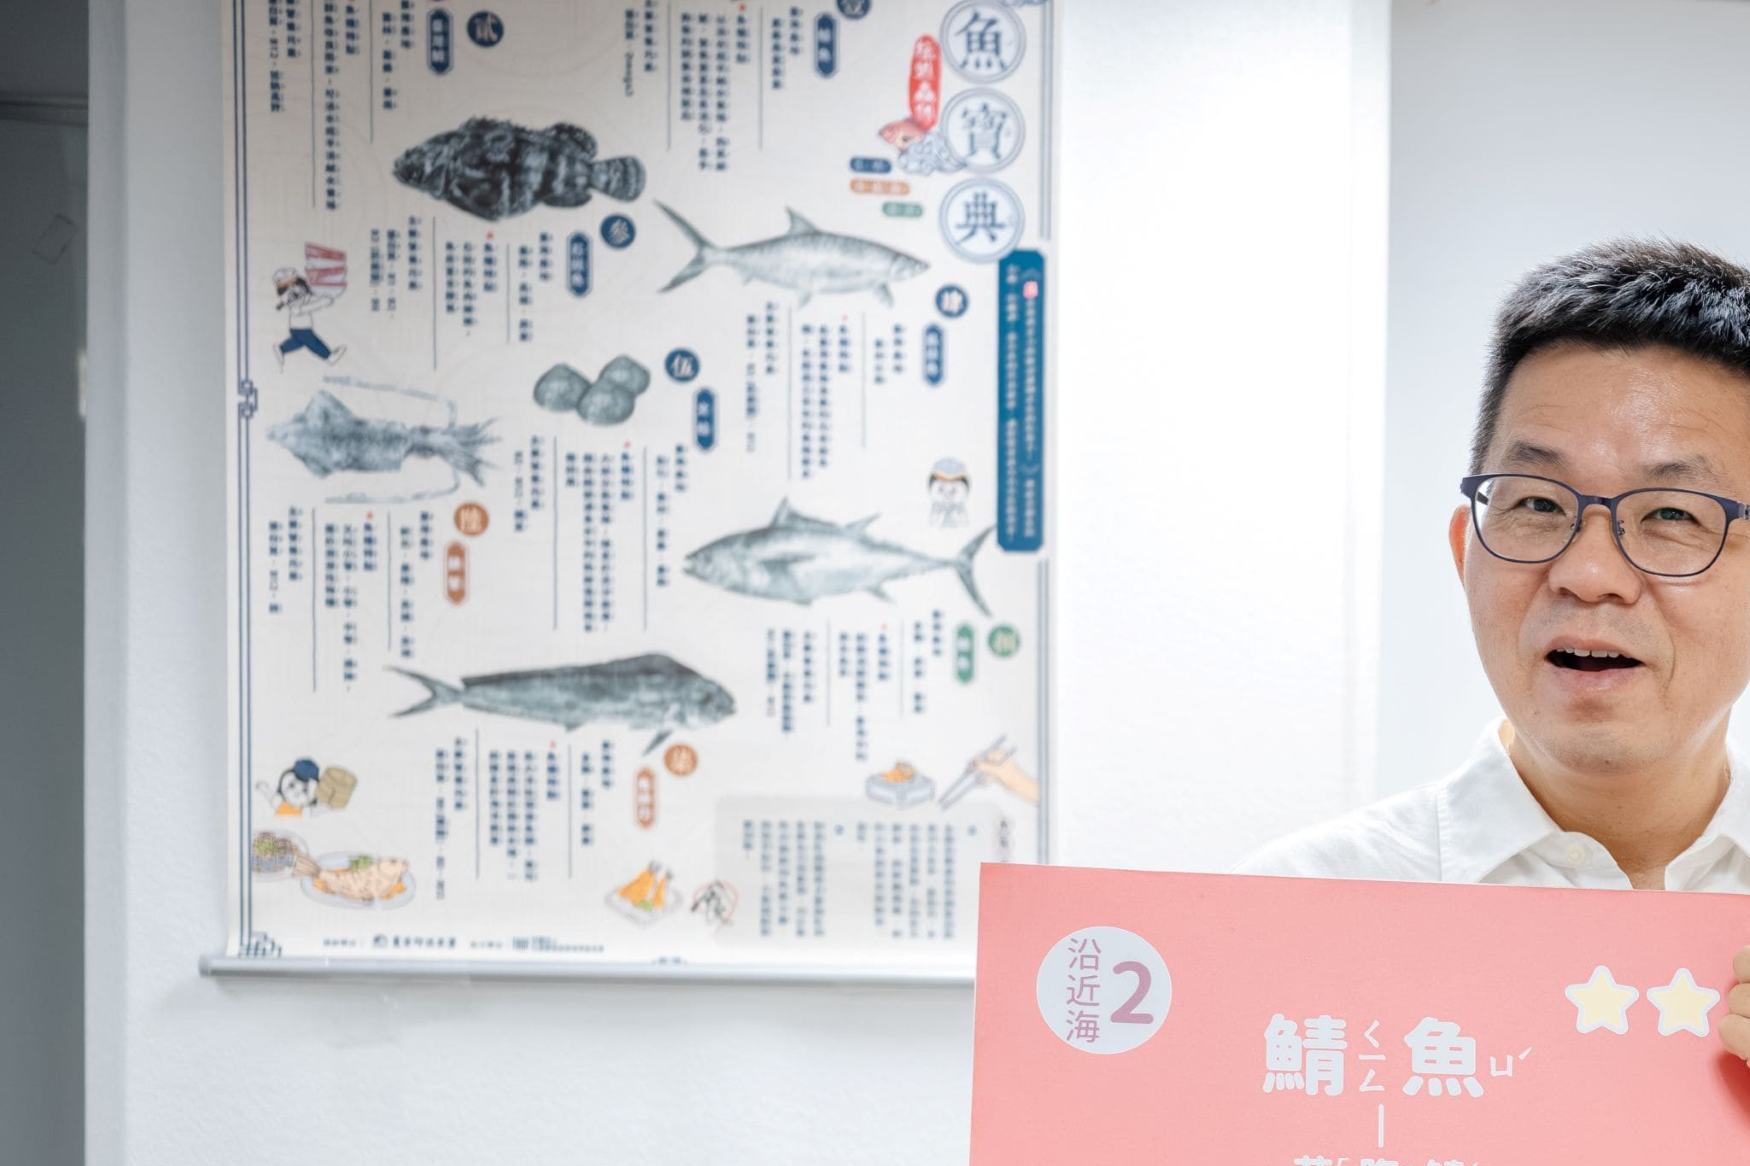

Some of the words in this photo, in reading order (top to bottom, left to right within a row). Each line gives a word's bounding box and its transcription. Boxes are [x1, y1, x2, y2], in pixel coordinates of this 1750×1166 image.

[955, 9, 1009, 246] 魚寶典
[1066, 938, 1101, 1043] 沿近海
[1110, 960, 1154, 1024] 2
